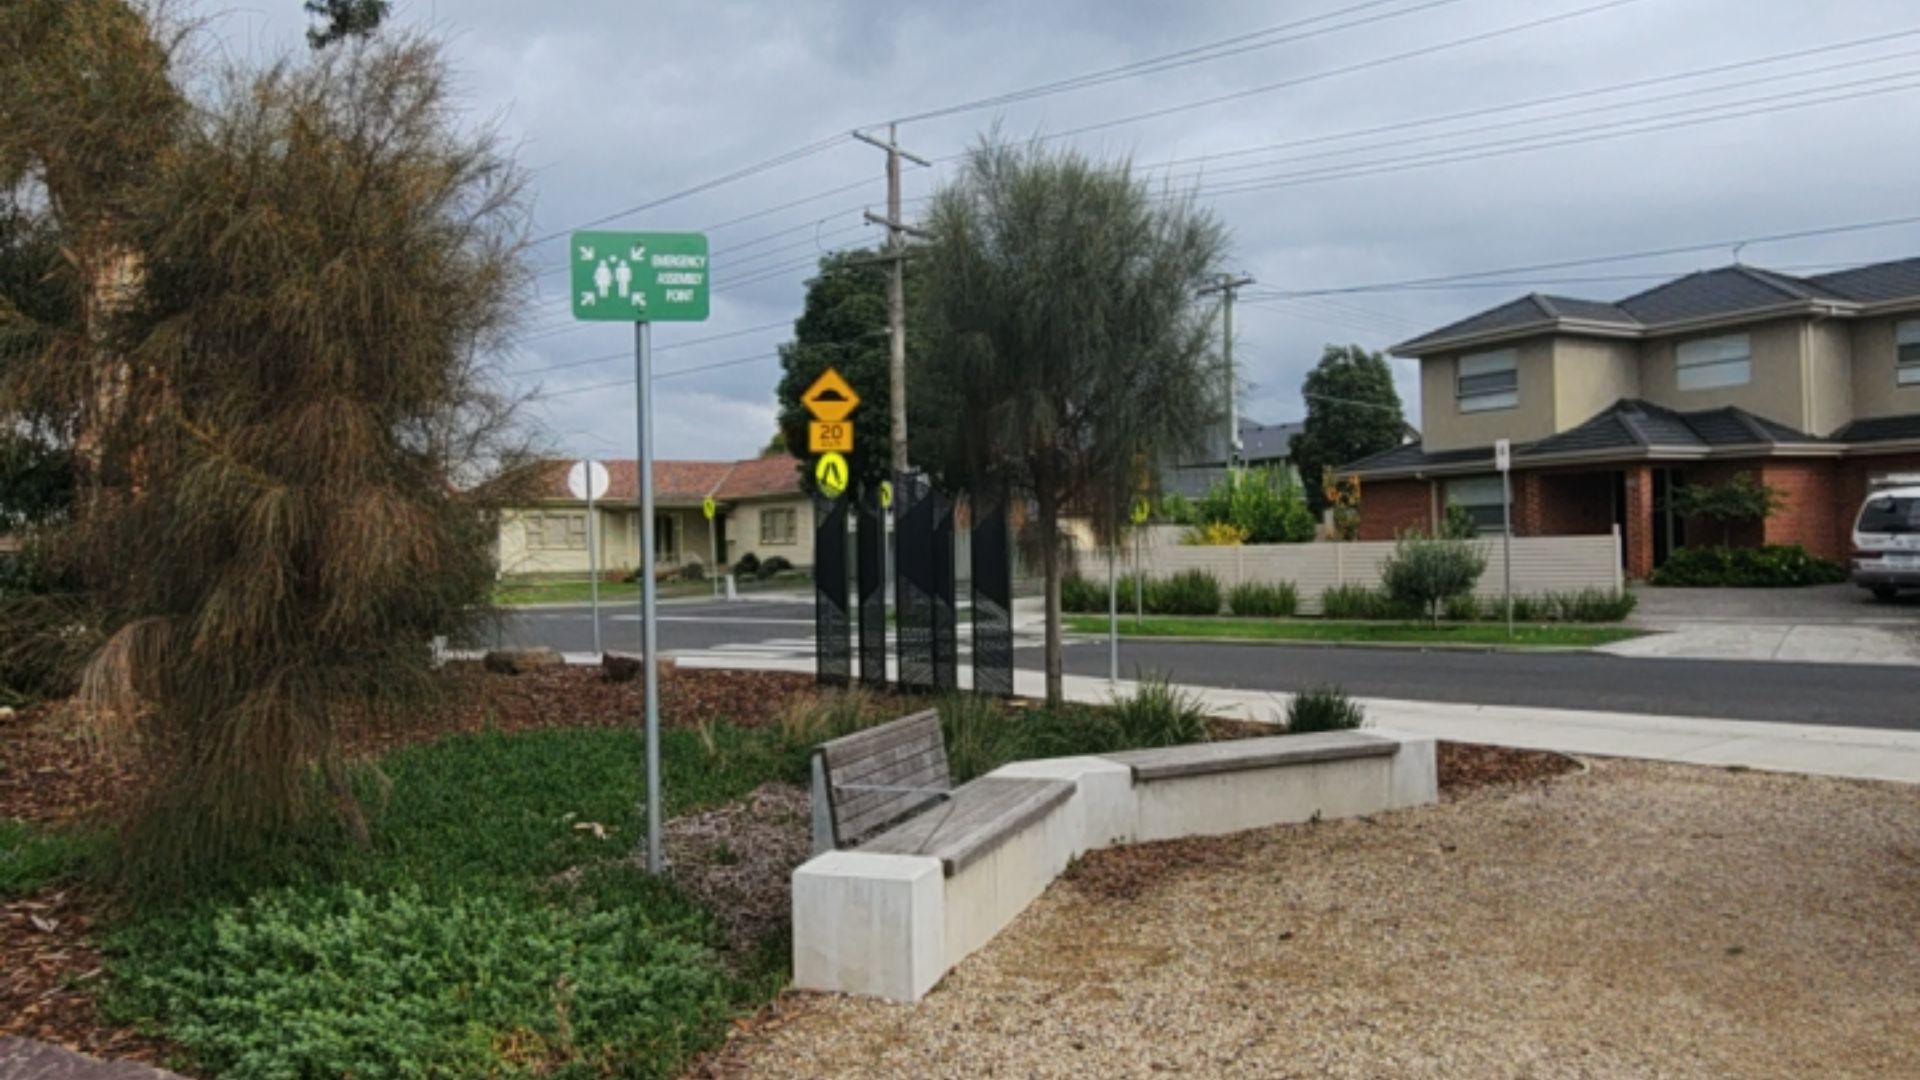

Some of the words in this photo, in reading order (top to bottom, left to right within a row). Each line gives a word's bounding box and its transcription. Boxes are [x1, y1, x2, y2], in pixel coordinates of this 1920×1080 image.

[651, 254, 706, 268] EMERGENCY
[656, 272, 704, 285] ASSEMBLY
[665, 288, 695, 303] POINT
[820, 424, 844, 440] 20
